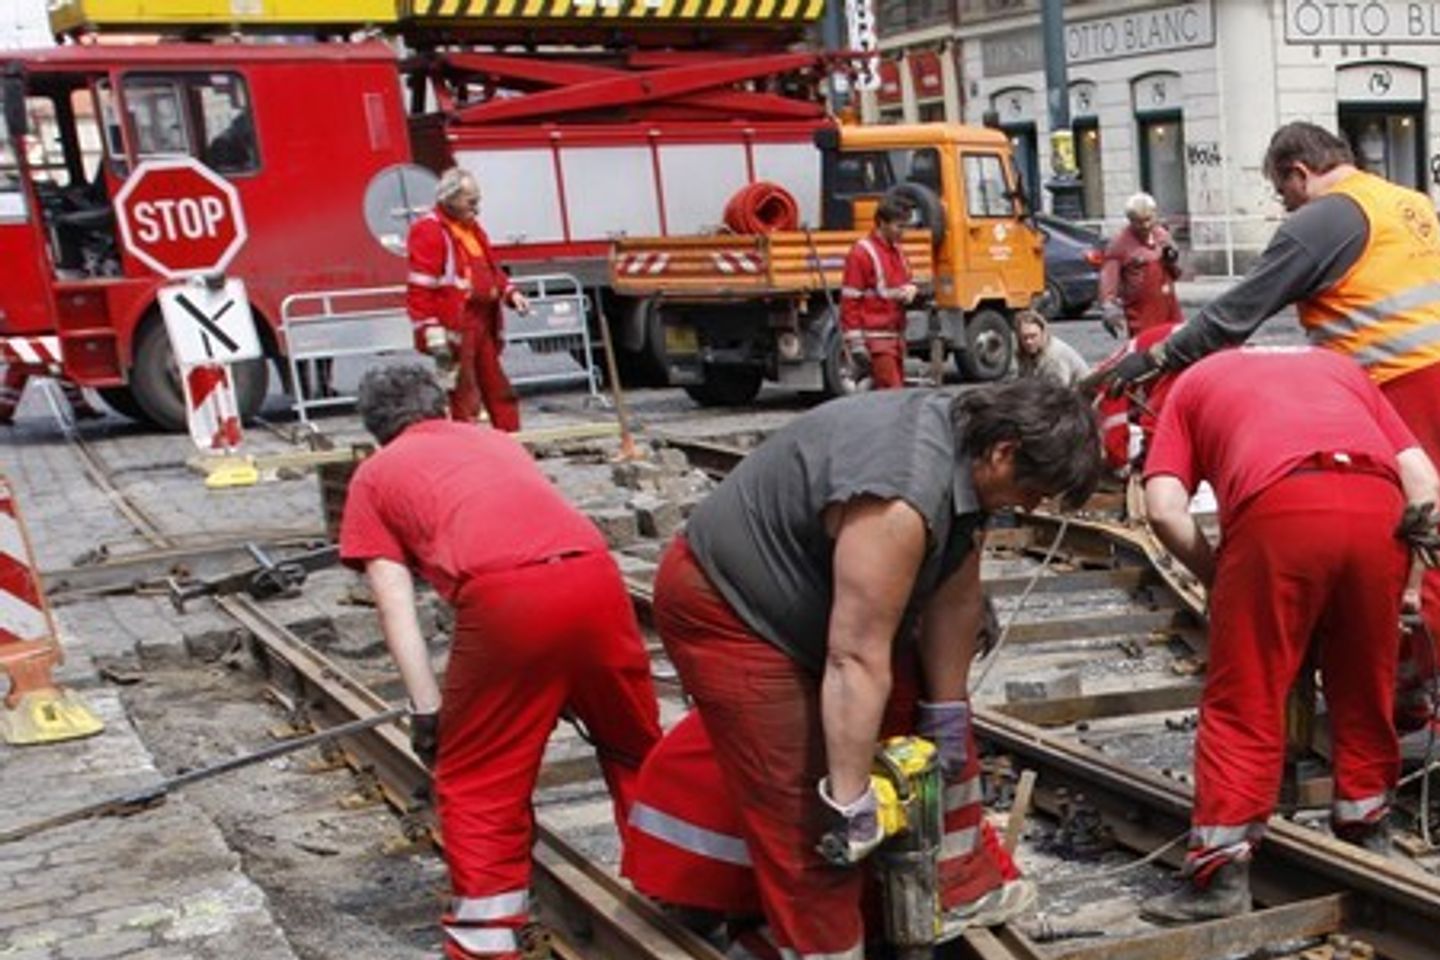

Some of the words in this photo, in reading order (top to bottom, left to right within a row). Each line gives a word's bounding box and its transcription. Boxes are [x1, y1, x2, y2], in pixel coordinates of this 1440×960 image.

[1068, 22, 1117, 59] OTTO
[1123, 7, 1198, 50] BLANC
[1296, 2, 1388, 36] OTTO
[134, 196, 225, 243] STOP
